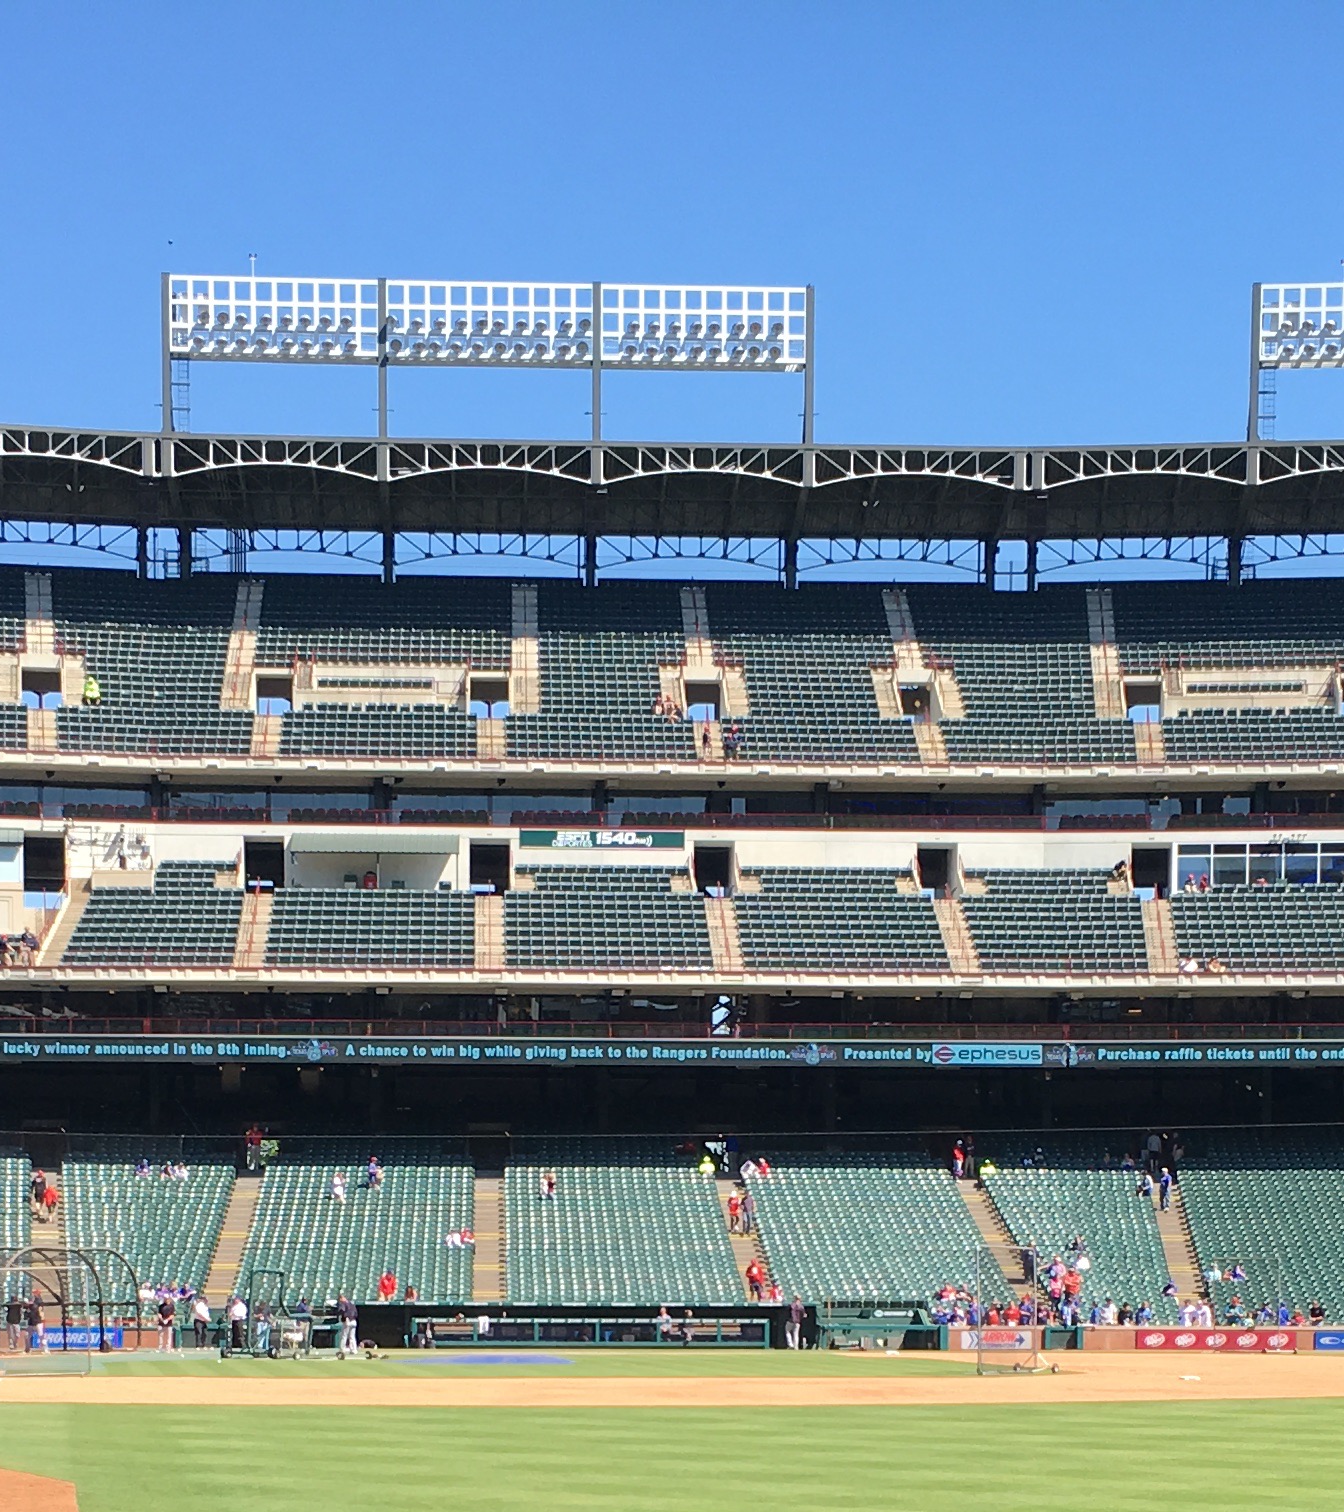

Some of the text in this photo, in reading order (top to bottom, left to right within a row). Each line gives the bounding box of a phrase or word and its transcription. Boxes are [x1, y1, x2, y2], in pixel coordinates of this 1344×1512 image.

[595, 831, 637, 845] 1540
[3, 1041, 41, 1057] lucky
[44, 1041, 91, 1055] winner
[94, 1042, 169, 1055] announced
[173, 1042, 187, 1055] in
[190, 1042, 214, 1055] the
[217, 1043, 240, 1056] 8th
[243, 1042, 294, 1059] inning.
[345, 1043, 356, 1056] A
[359, 1044, 409, 1057] chance
[412, 1044, 427, 1057] to
[430, 1044, 455, 1057] win
[459, 1044, 481, 1060] big
[484, 1044, 522, 1058] while
[525, 1045, 567, 1061] giving
[570, 1045, 604, 1058] back
[607, 1046, 622, 1059] to
[625, 1046, 649, 1059] the
[652, 1046, 708, 1062] Rangers
[711, 1046, 793, 1061] Foundation.
[843, 1047, 912, 1060] Presented
[915, 1047, 933, 1063] by
[958, 1047, 1041, 1062] ephesus
[1097, 1048, 1161, 1061] Purchase
[1164, 1047, 1203, 1060] raffle
[1206, 1047, 1255, 1060] tickets
[1258, 1047, 1291, 1060] until
[1294, 1047, 1318, 1060] the
[982, 1331, 1017, 1344] ARROW
